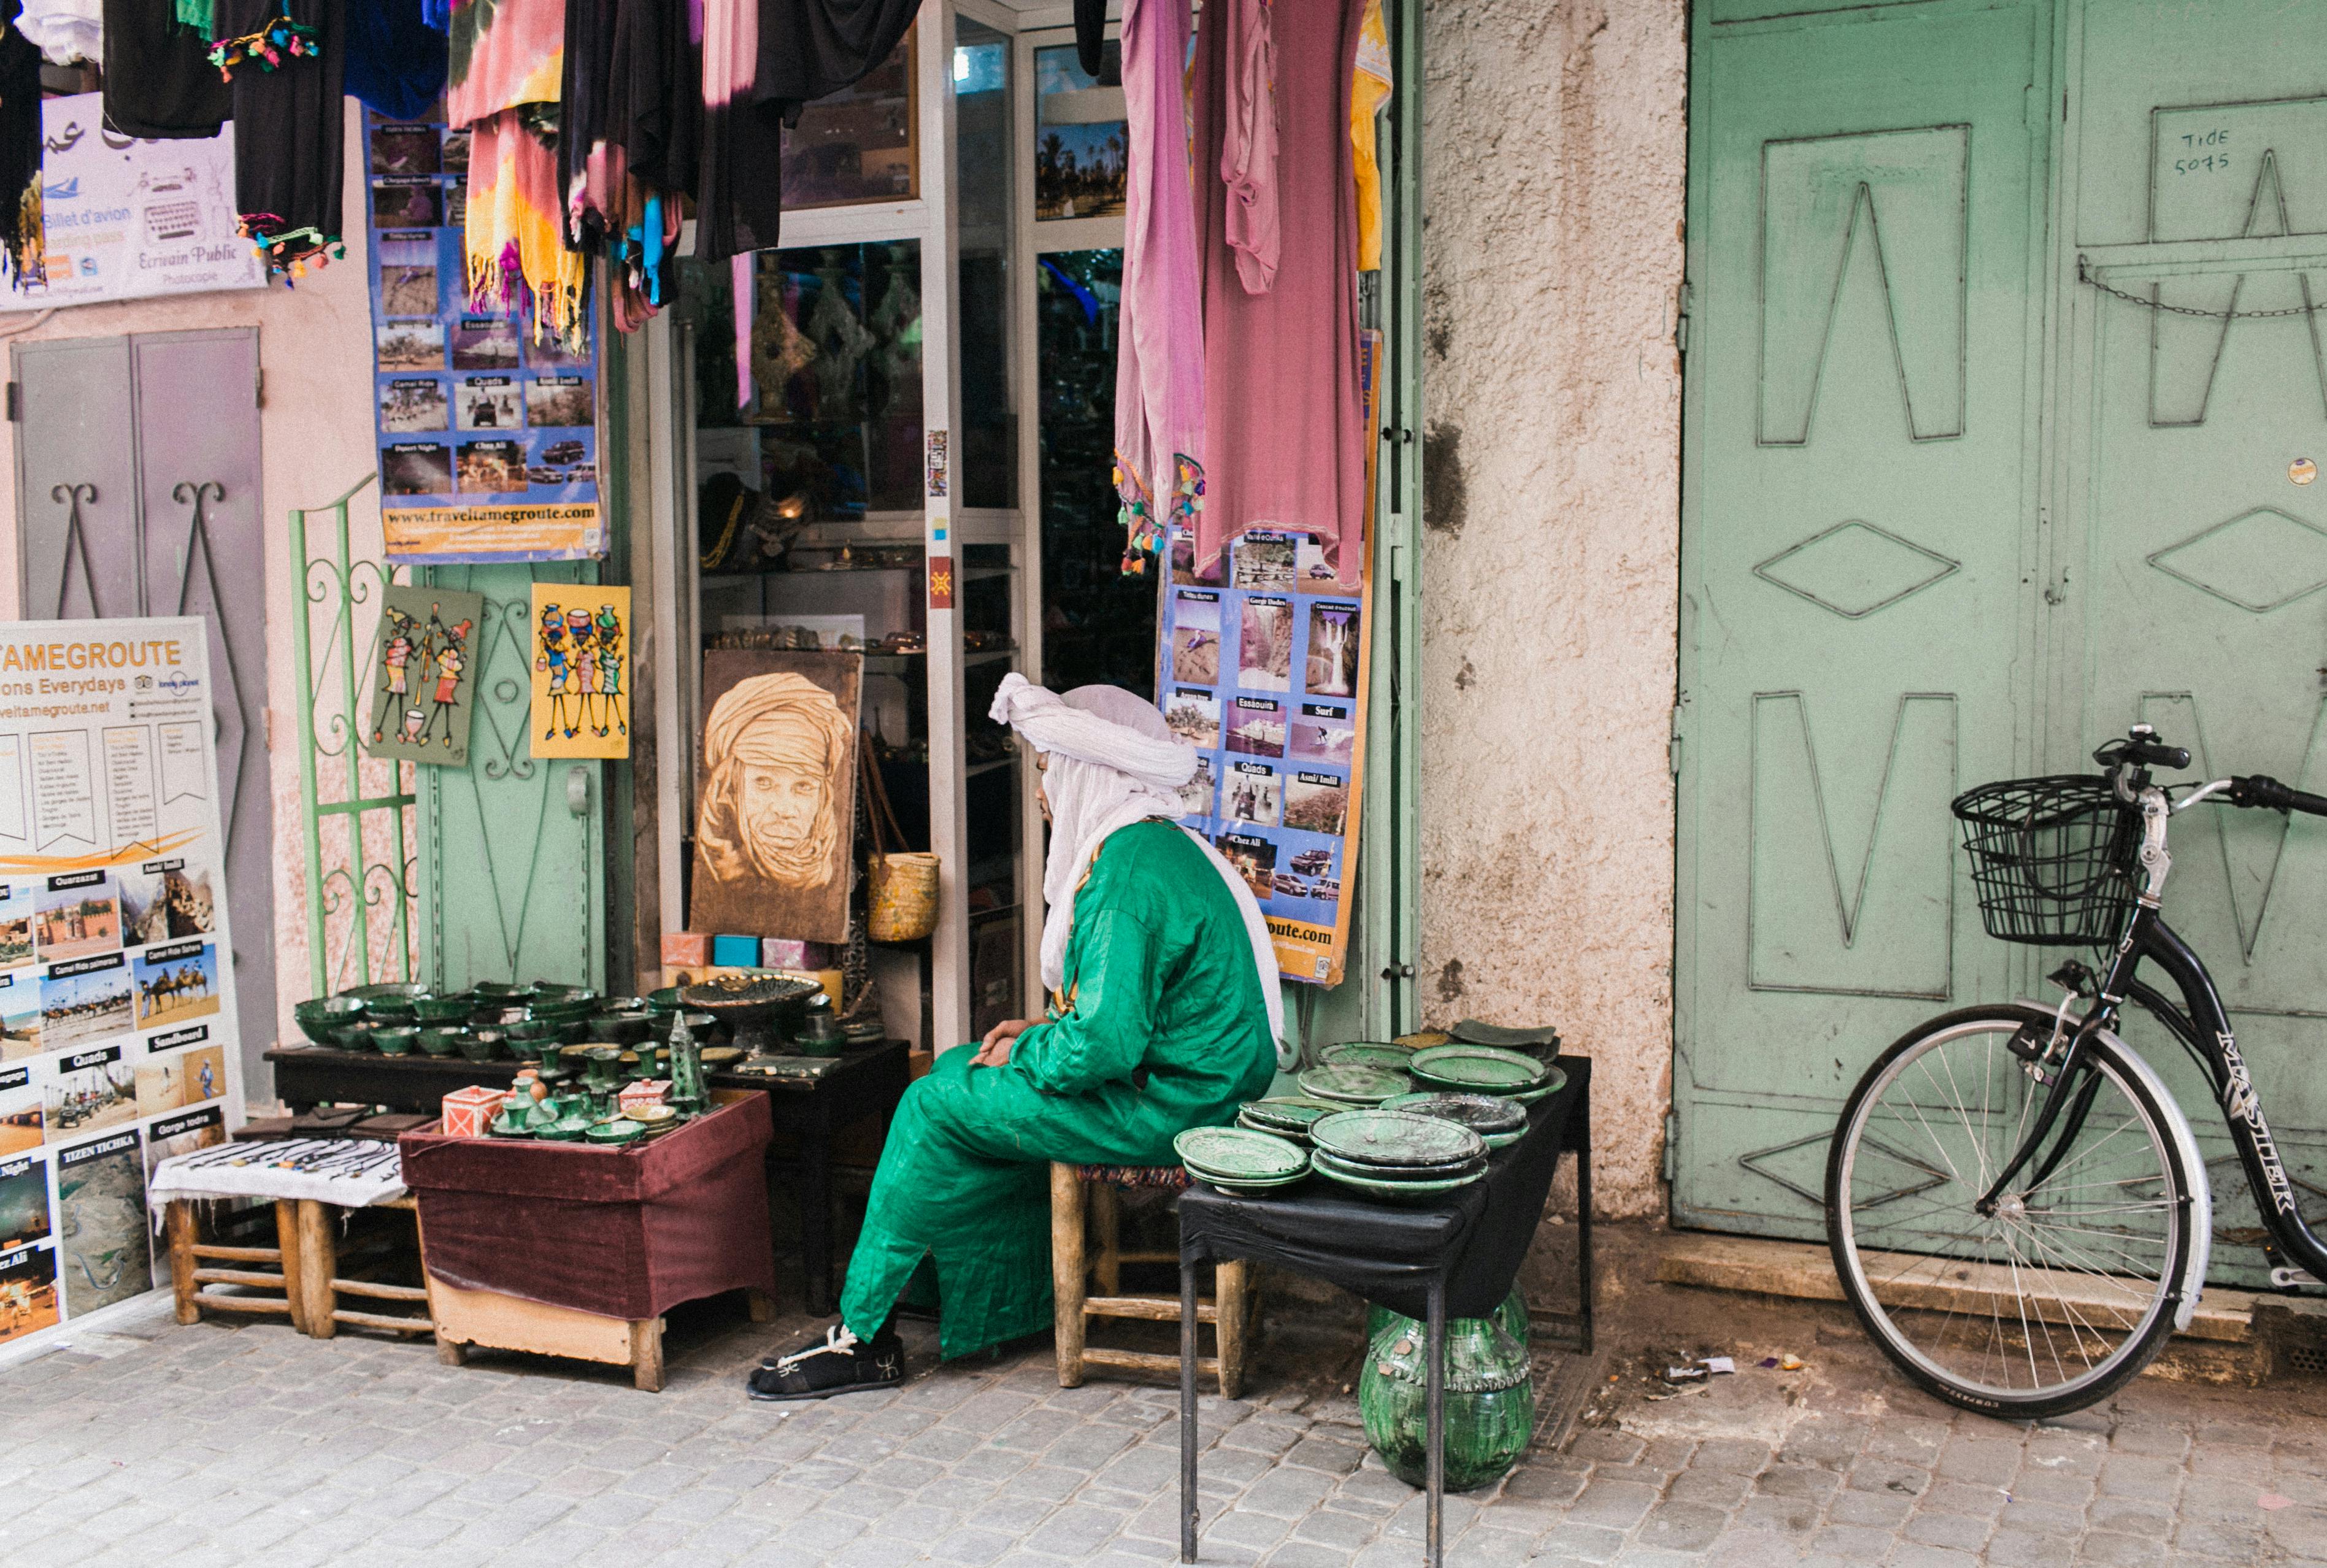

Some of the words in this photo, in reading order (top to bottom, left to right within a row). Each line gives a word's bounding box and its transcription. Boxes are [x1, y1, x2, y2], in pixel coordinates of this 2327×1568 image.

[2175, 153, 2229, 175] 5075
[44, 211, 79, 229] Billet
[80, 207, 131, 225] d'avion
[191, 244, 237, 263] Public
[388, 507, 595, 524] www.traveltamegroute.com
[0, 640, 181, 672] AMEGROUTE
[39, 677, 126, 696] Everydays
[1239, 698, 1274, 710] Essaouira
[1315, 706, 1333, 717] Surf
[1241, 763, 1266, 775] Quads
[1320, 775, 1337, 785] Imlil
[1233, 835, 1250, 845] Chez
[1250, 838, 1261, 847] Ali
[55, 964, 73, 975] Camel
[154, 1028, 202, 1048] Sandboard
[73, 1050, 108, 1067] Quads
[158, 1121, 185, 1136] Gorge
[2215, 1030, 2296, 1216] MASTER
[63, 1144, 96, 1163] TIZEN
[97, 1134, 135, 1154] TICHKA
[1, 1161, 29, 1177] Night
[10, 1250, 28, 1267] Ali
